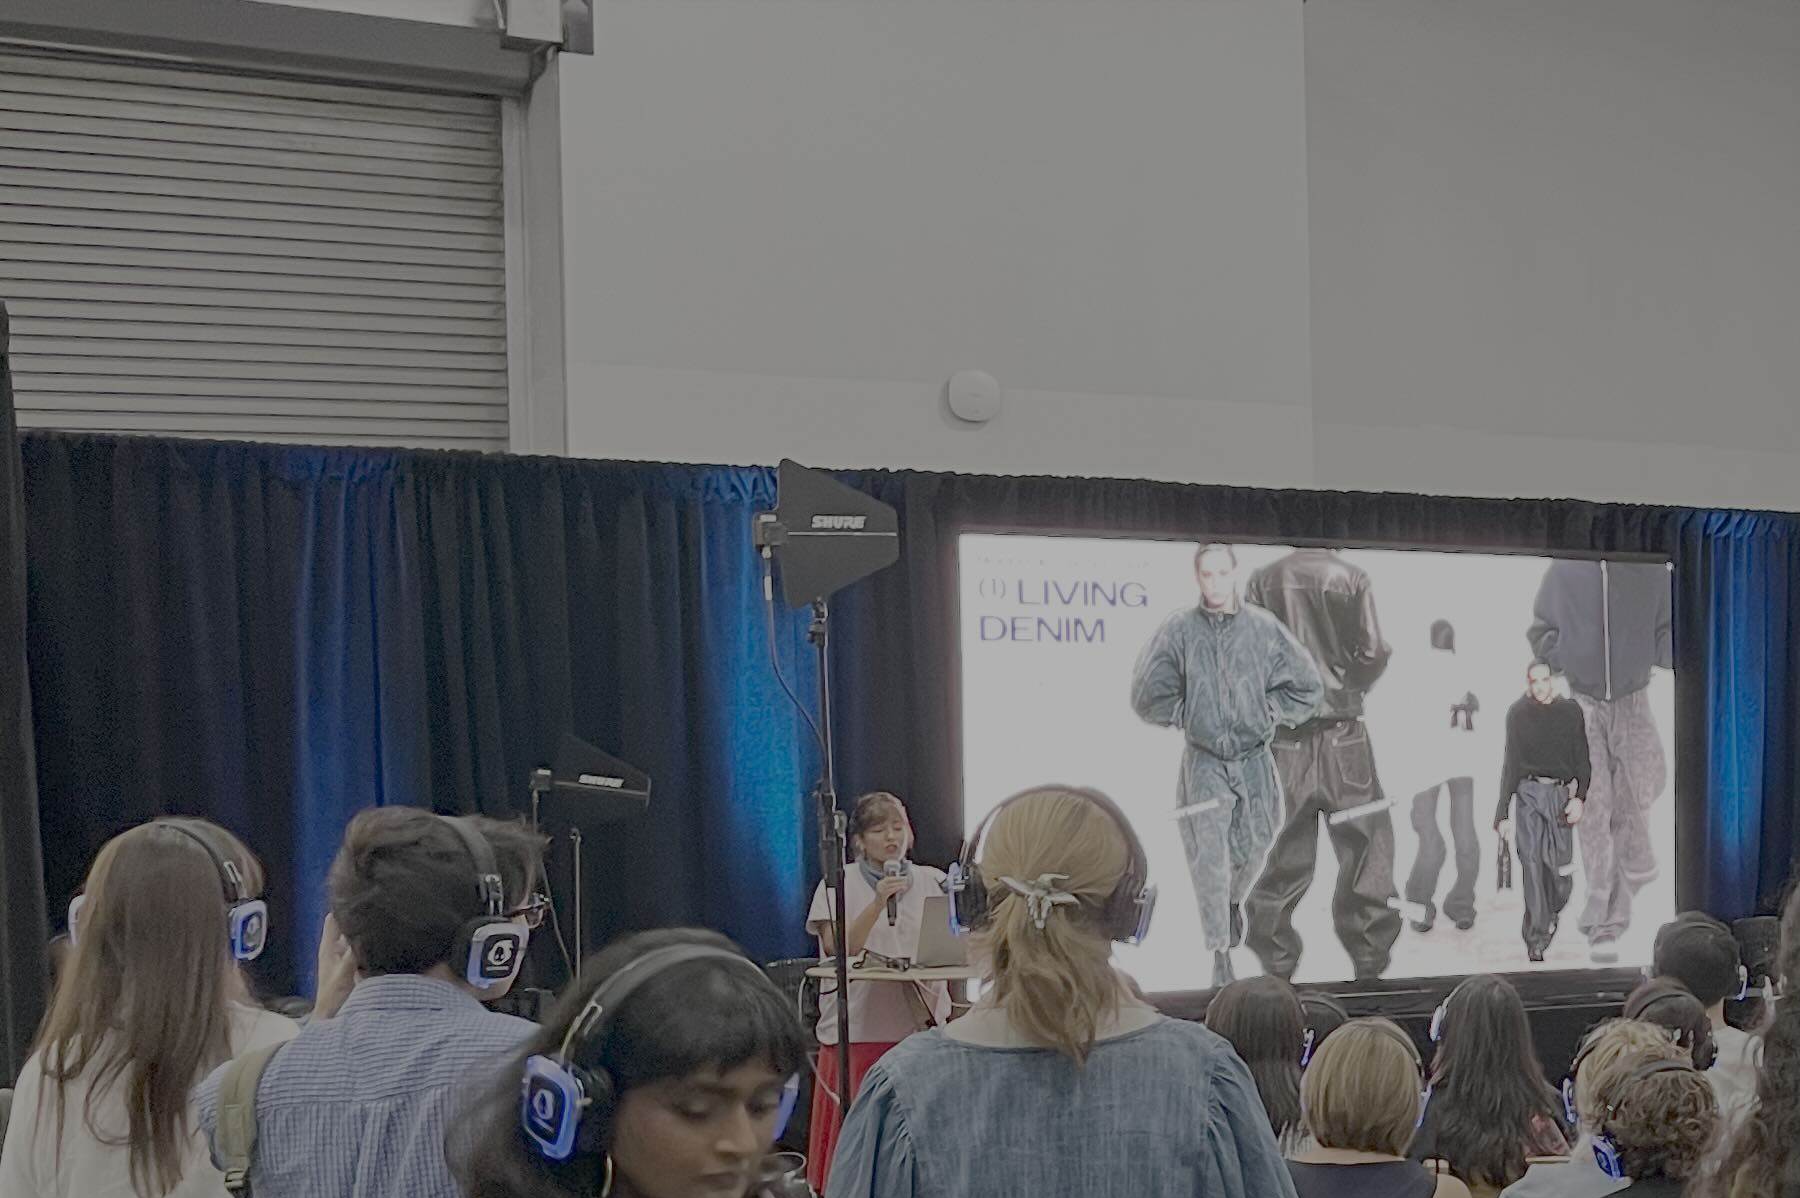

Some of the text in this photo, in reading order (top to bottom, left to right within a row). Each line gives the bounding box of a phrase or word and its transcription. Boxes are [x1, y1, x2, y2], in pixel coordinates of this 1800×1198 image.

[811, 515, 867, 529] SHURE
[1017, 579, 1148, 607] LIVING
[979, 615, 1106, 643] DENIM
